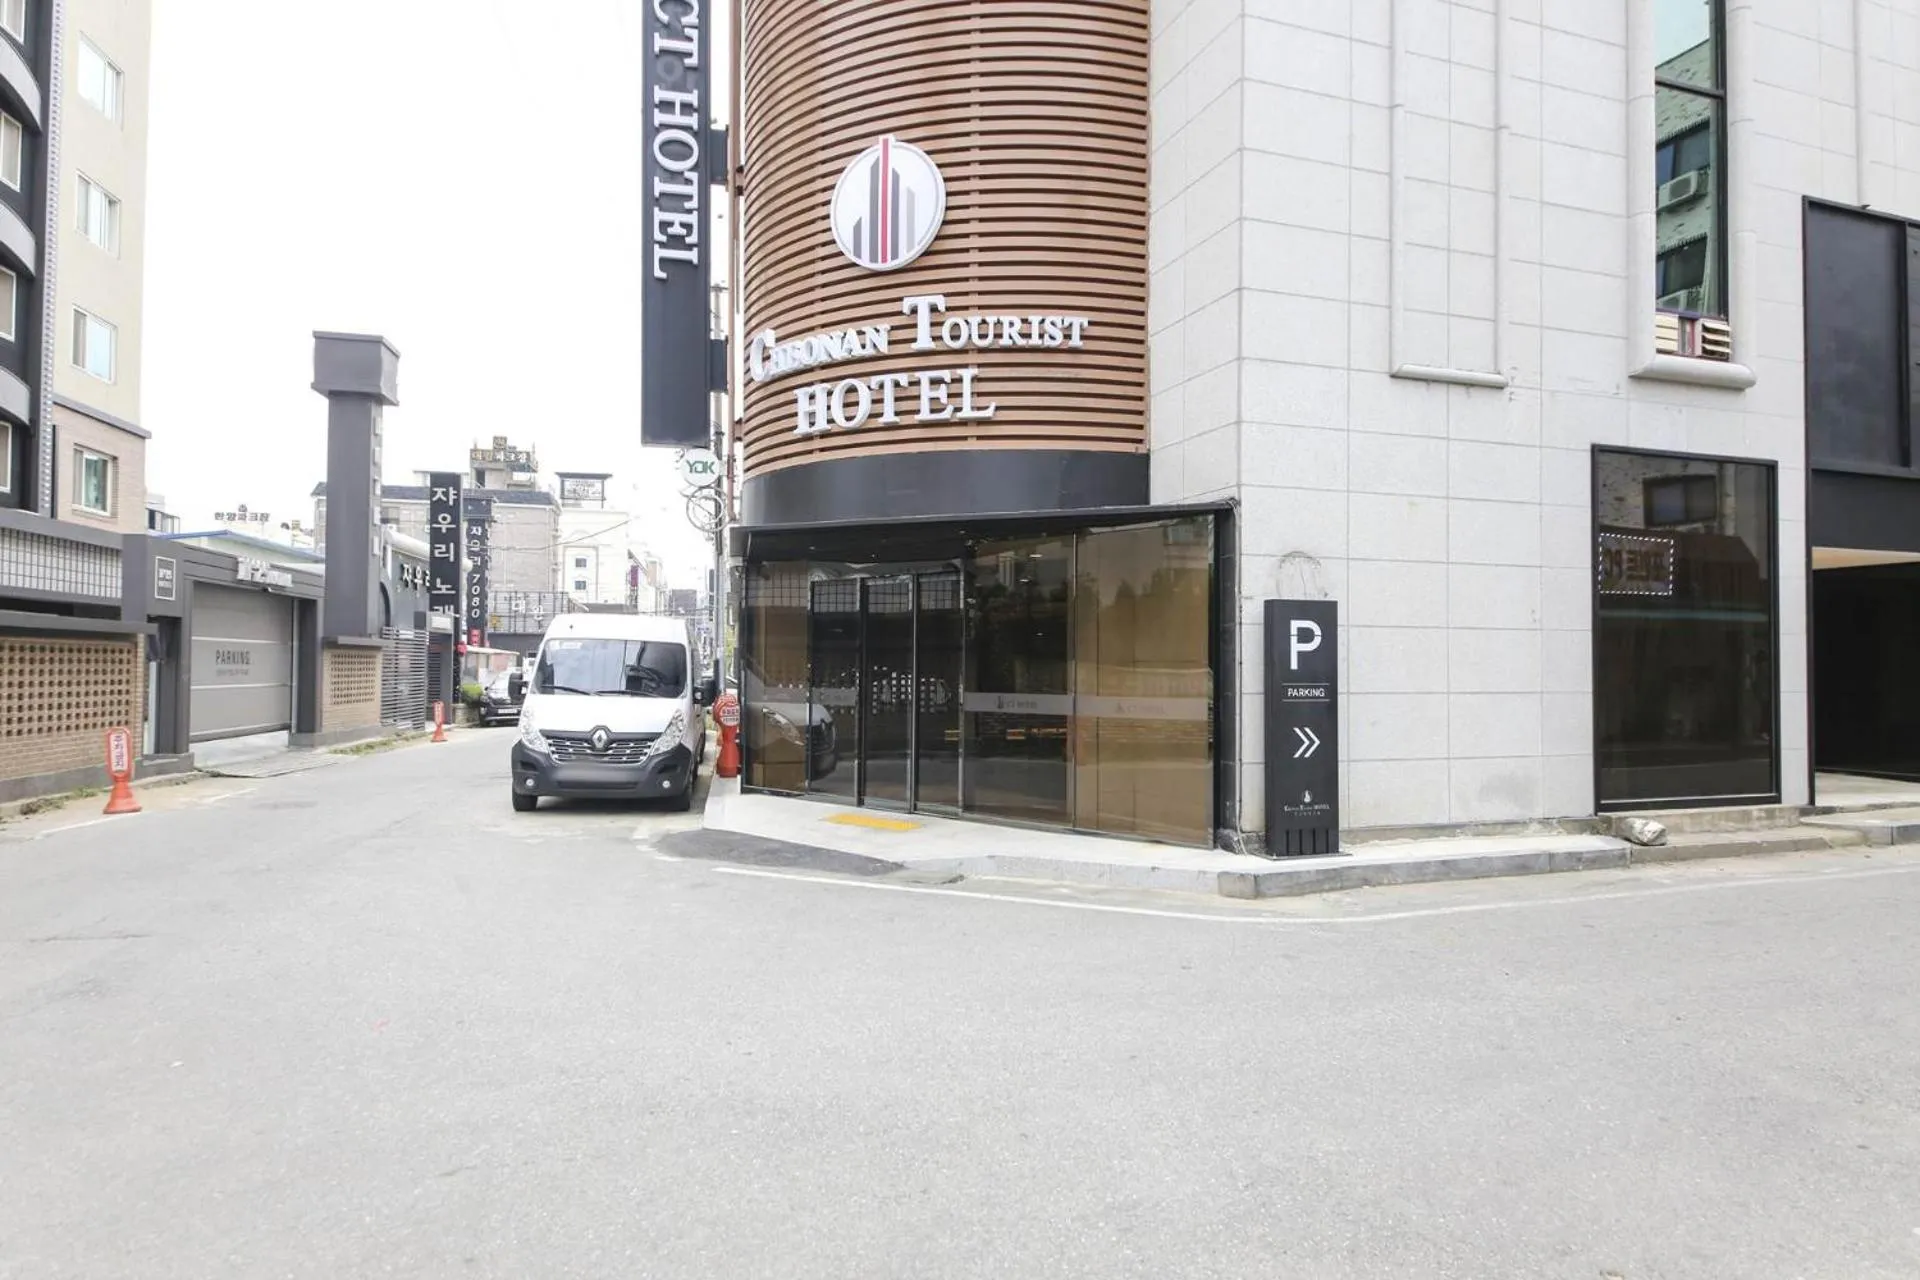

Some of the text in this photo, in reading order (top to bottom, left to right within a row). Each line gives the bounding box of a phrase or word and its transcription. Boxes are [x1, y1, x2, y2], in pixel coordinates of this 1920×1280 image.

[652, 0, 699, 282] CT HOTEL
[903, 294, 1088, 350] TOURIST
[793, 368, 996, 437] HOTEL
[432, 486, 458, 563] 쟈우리
[471, 573, 481, 619] 7080
[1290, 620, 1322, 670] P
[1287, 688, 1325, 697] PARKING
